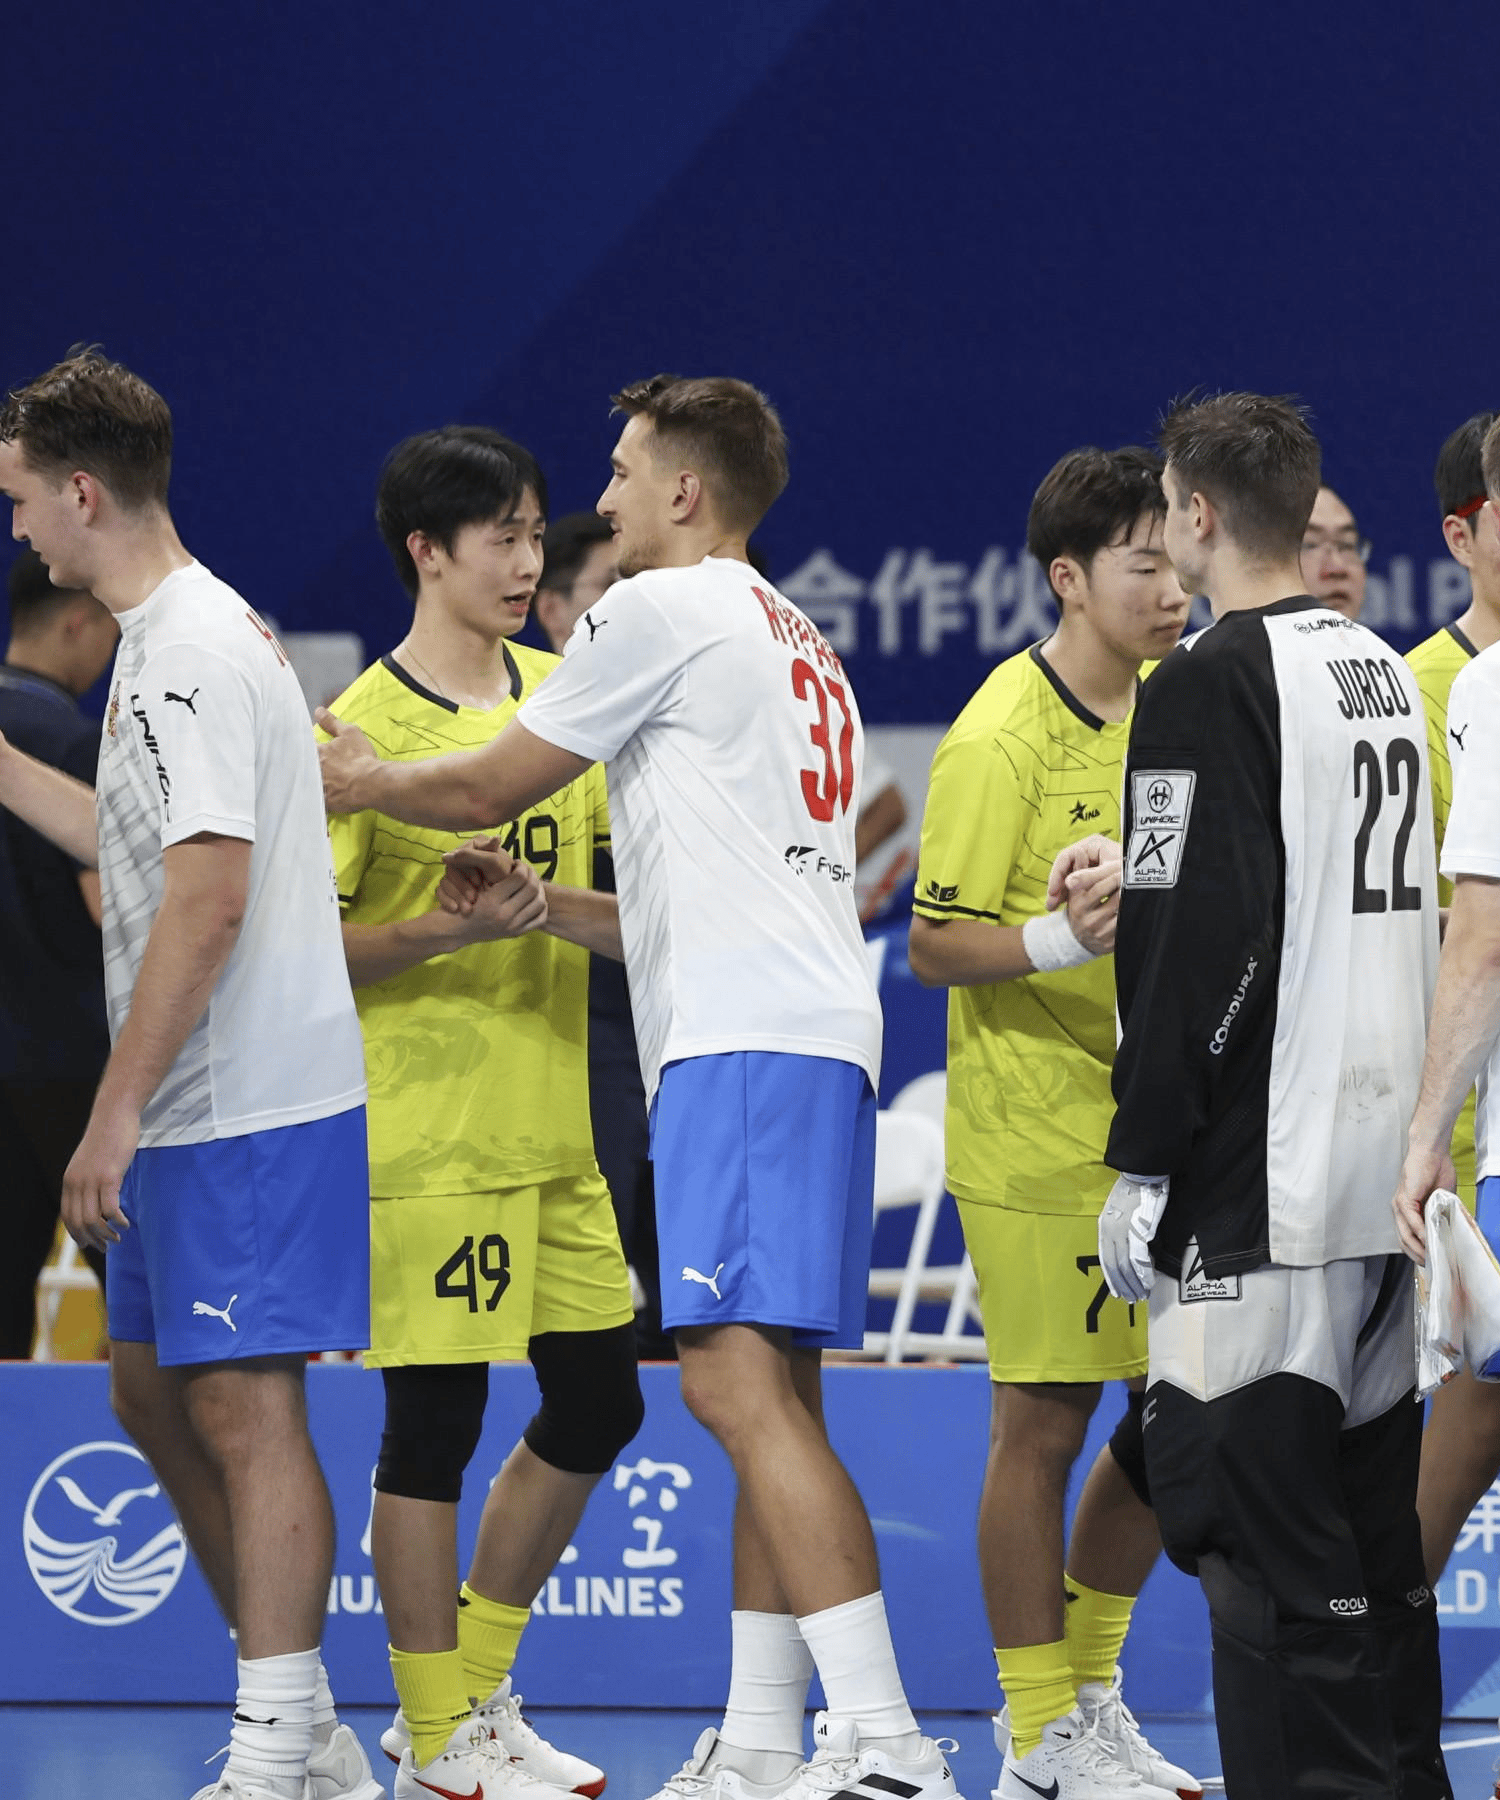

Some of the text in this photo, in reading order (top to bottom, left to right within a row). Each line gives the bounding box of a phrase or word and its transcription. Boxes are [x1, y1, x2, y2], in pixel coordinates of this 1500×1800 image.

[1326, 658, 1411, 720] JURCO
[1352, 738, 1421, 914] 22
[1134, 868, 1168, 876] ALPHA
[1209, 956, 1258, 1055] CORDURA
[434, 1233, 511, 1313] 49
[1186, 1282, 1227, 1292] ALPHA
[527, 1576, 684, 1617] LINES
